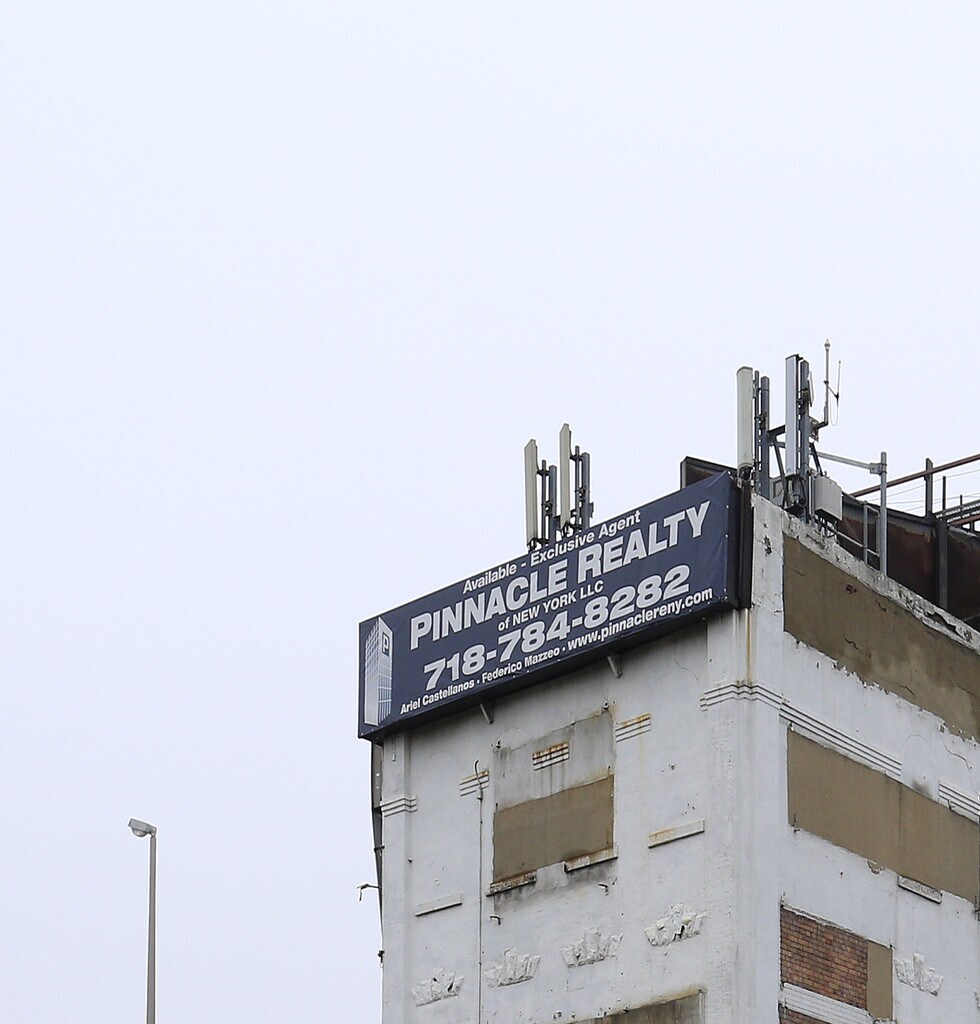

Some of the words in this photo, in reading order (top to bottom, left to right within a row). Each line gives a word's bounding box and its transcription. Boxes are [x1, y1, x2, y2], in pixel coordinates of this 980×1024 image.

[410, 558, 568, 651] PINNACLE
[577, 500, 711, 584] REALTY
[463, 562, 517, 594] Available
[531, 530, 595, 566] Exclusive
[598, 510, 641, 539] Agent
[498, 618, 510, 632] of
[512, 605, 539, 625] NEW
[543, 591, 577, 613] YORK
[580, 580, 604, 599] LLC
[400, 698, 421, 715] Ariel
[422, 679, 475, 706] Castellanos
[481, 662, 522, 684] Federico
[524, 647, 560, 667] Mazzeo
[567, 587, 713, 651] www.pinnaclereny.com
[423, 564, 691, 691] 718-784-8282
